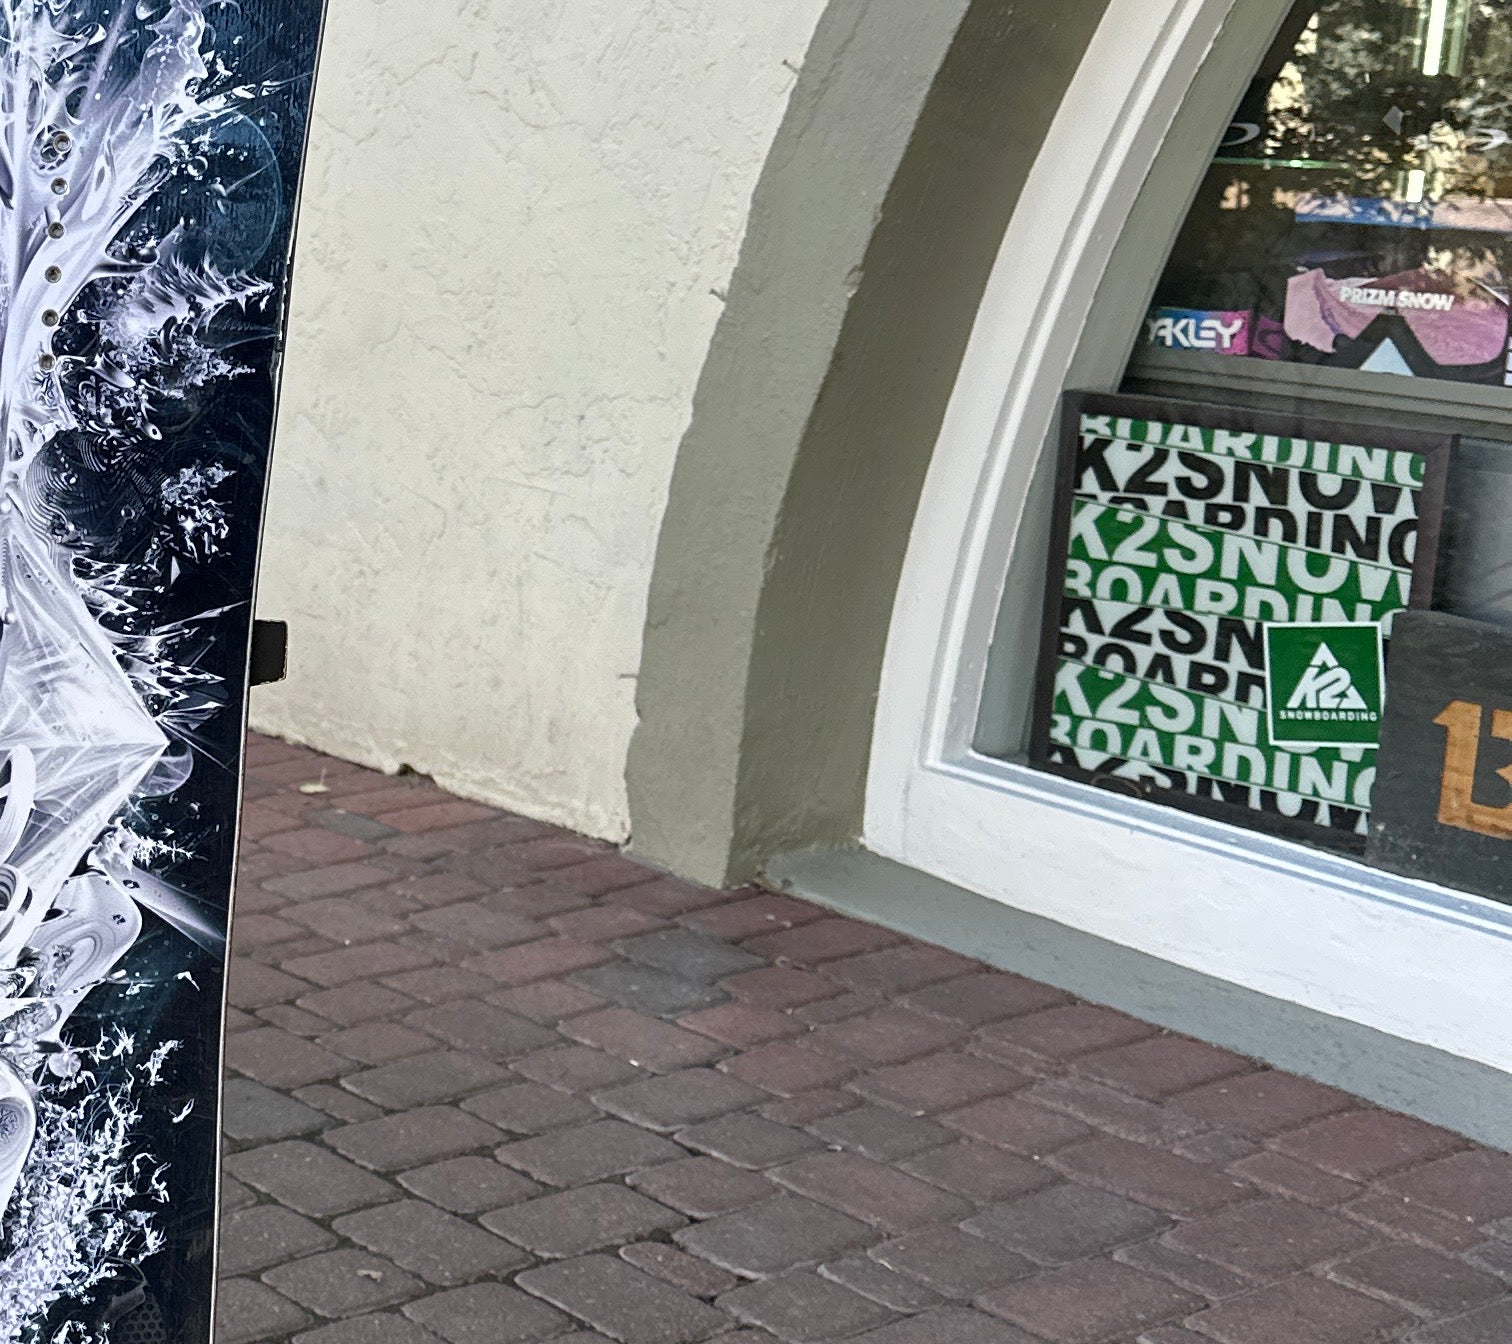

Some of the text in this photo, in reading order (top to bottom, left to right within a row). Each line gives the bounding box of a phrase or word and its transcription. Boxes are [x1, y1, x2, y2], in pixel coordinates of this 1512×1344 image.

[1339, 285, 1455, 312] PRIZM SNOW
[1148, 317, 1243, 348] AKLEY
[1279, 709, 1377, 722] SNOWBOARDING
